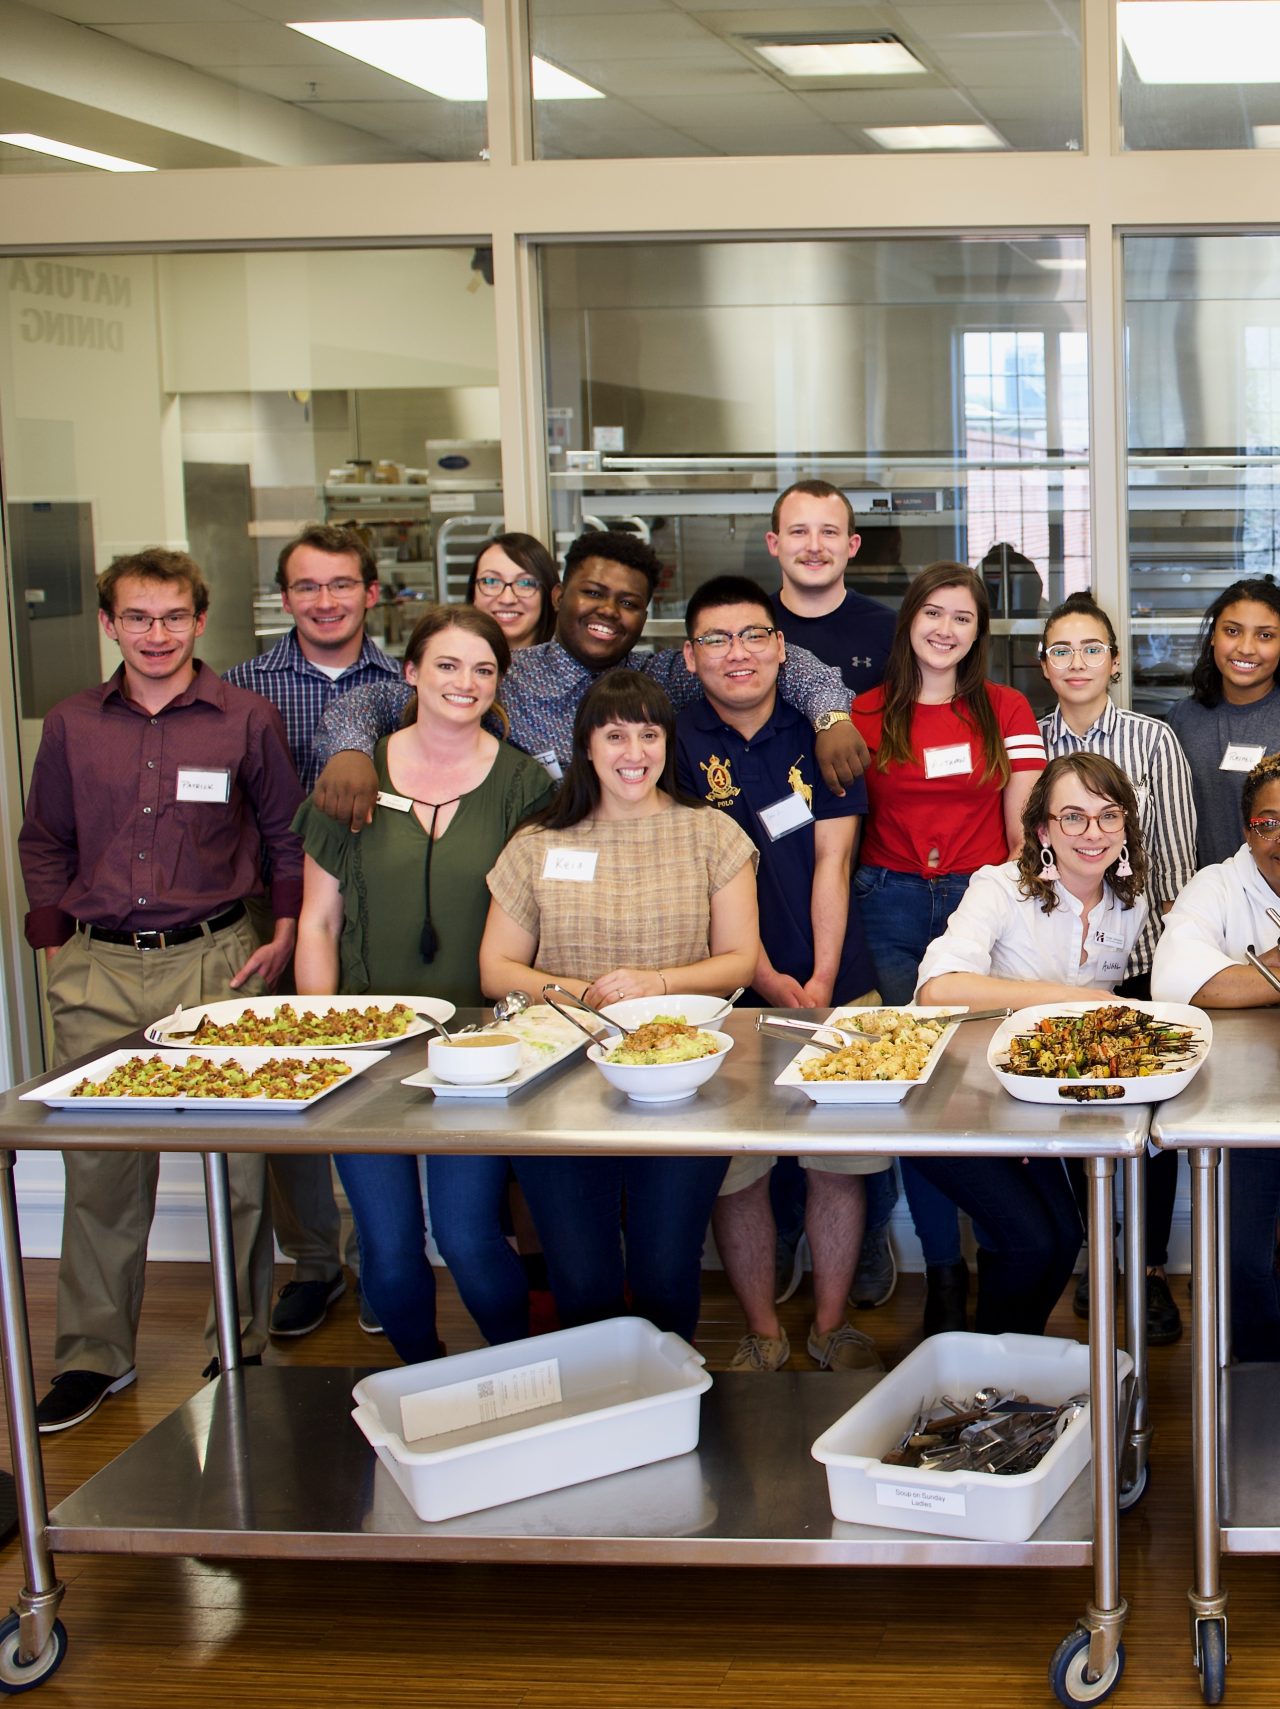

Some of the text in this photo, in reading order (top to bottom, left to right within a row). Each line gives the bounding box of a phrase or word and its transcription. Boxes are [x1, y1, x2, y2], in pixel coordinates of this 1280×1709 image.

[714, 769, 726, 787] 4
[717, 799, 734, 808] POLO
[895, 1488, 912, 1499] Soup
[921, 1492, 946, 1503] Sunday
